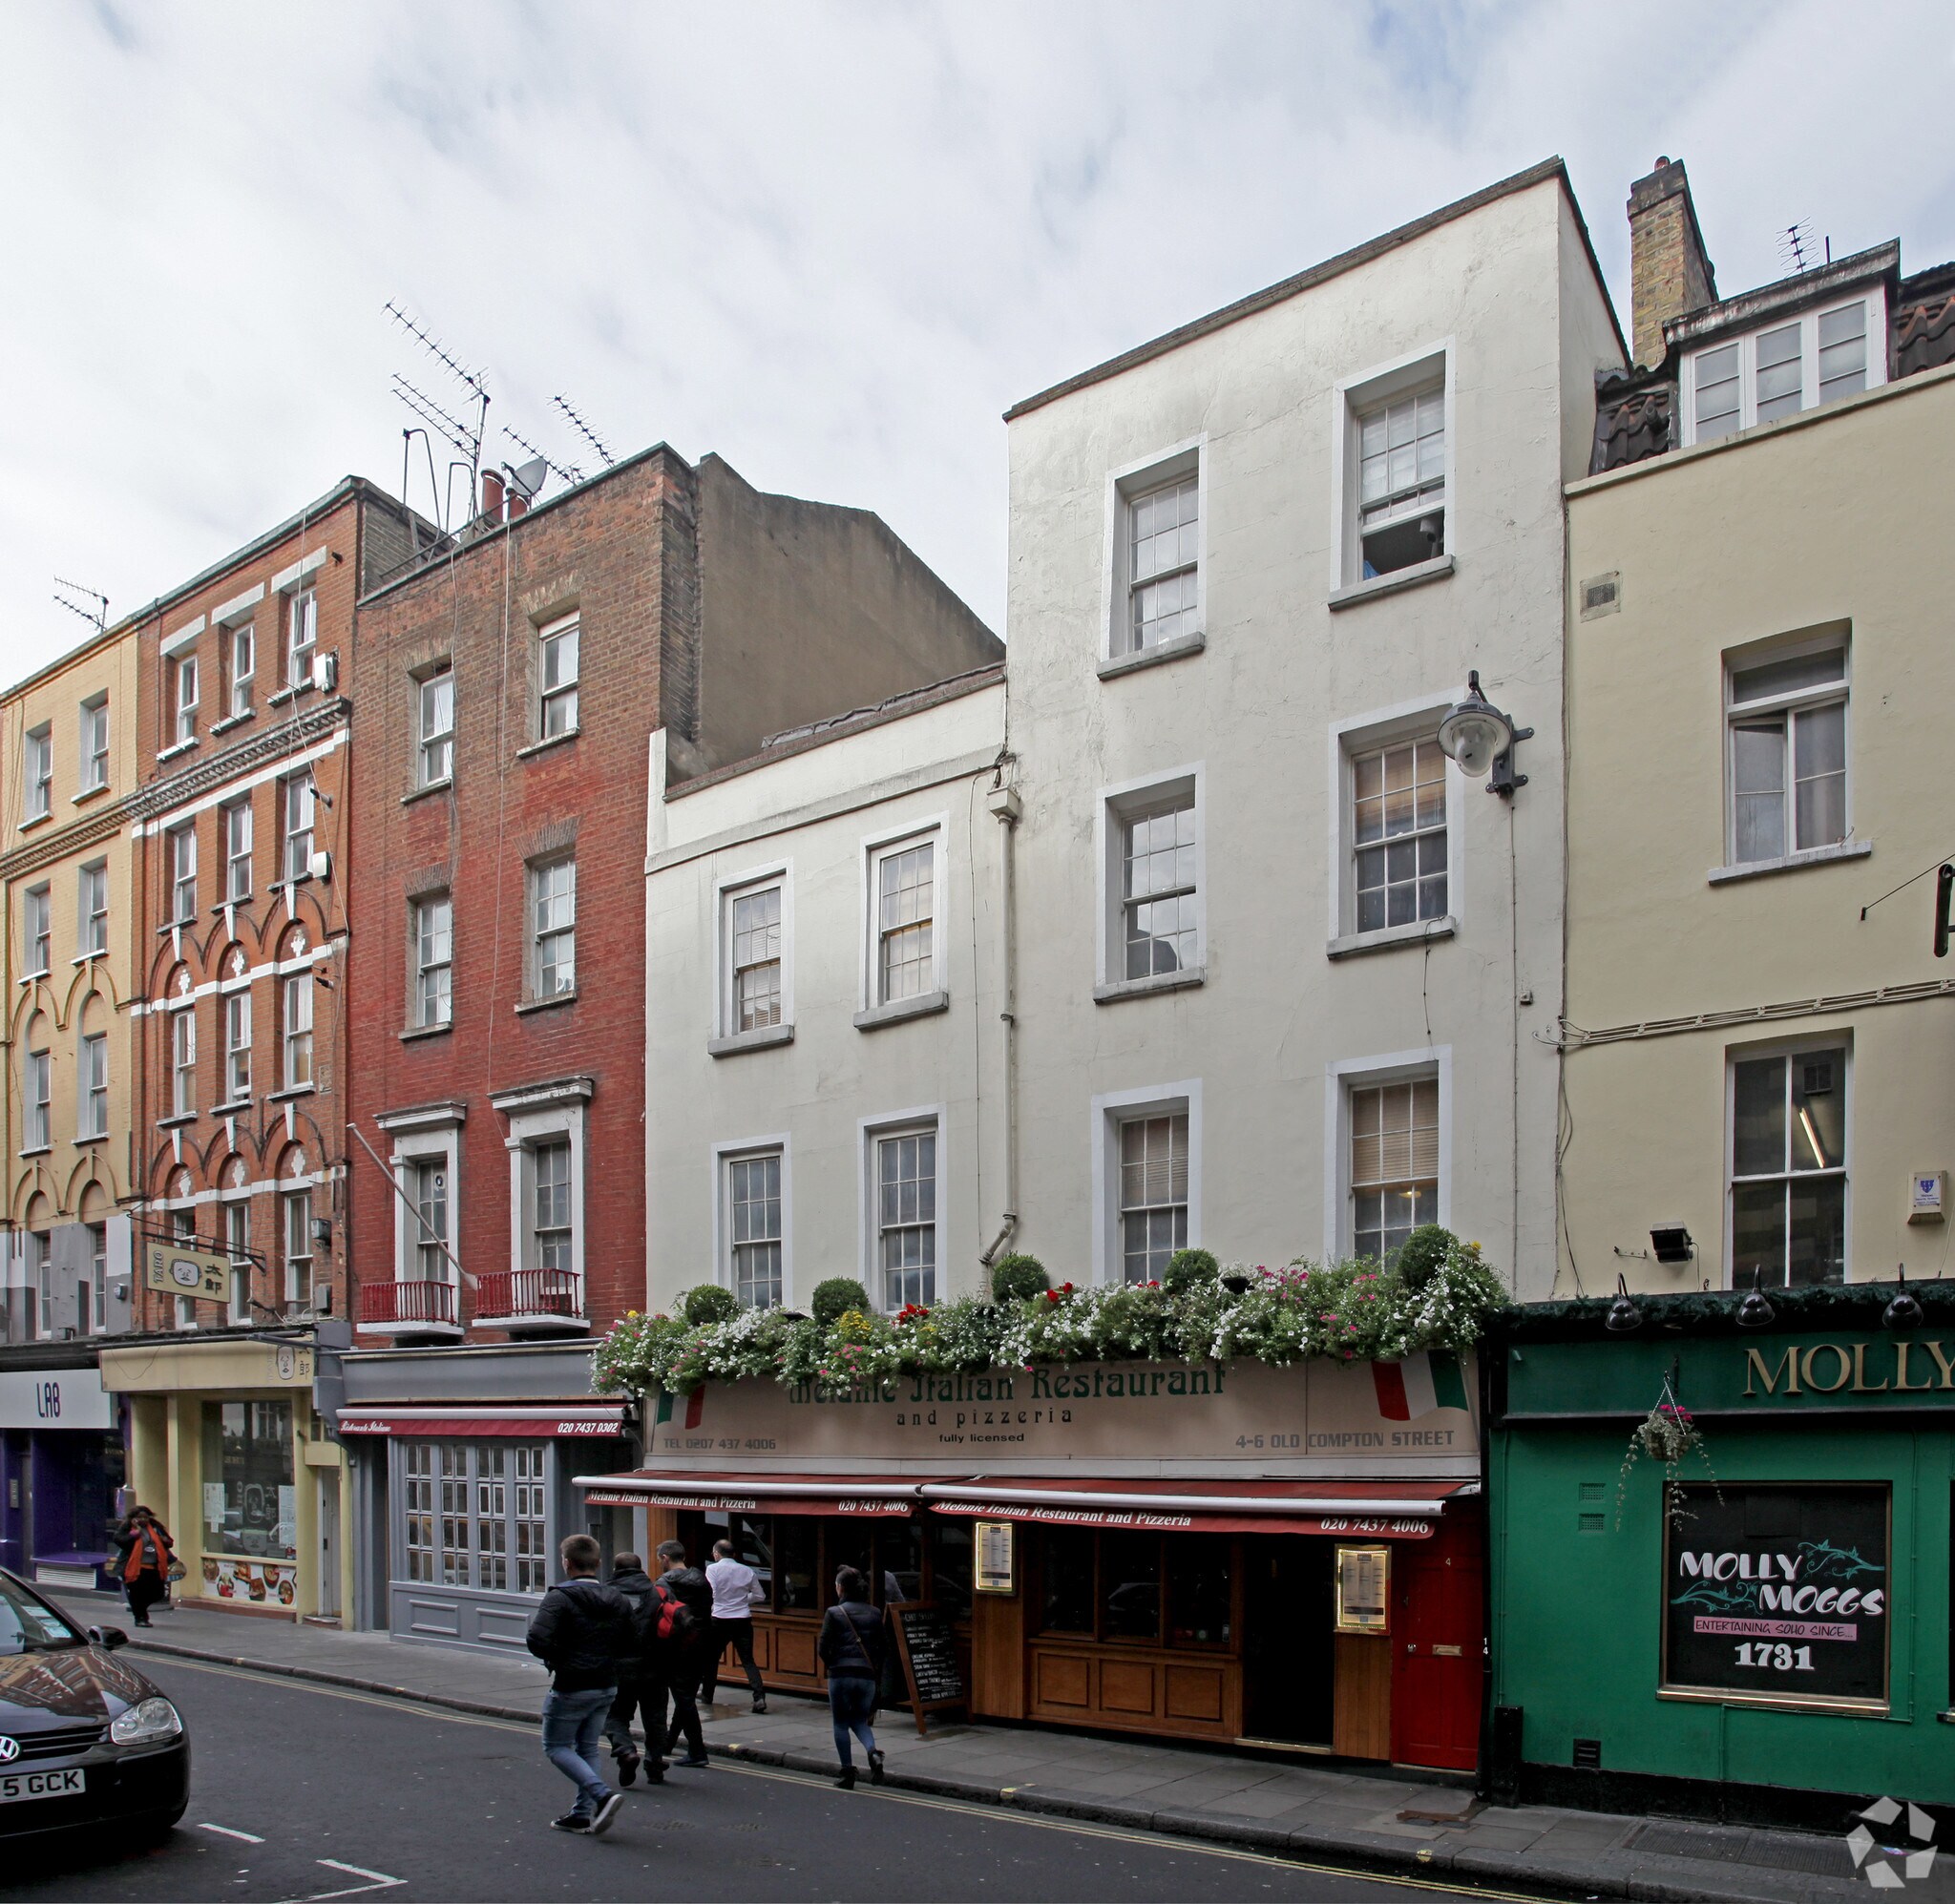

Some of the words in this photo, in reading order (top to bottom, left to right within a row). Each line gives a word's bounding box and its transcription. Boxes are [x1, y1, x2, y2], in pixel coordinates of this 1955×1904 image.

[153, 1250, 163, 1284] TARO
[204, 1264, 223, 1295] 太郎
[1742, 1341, 1955, 1395] MOLLY
[910, 1372, 1014, 1402] Italian
[1031, 1364, 1226, 1399] Restaurant
[36, 1382, 61, 1418] LAB
[557, 1422, 574, 1433] 020
[575, 1422, 597, 1433] 7437
[897, 1410, 936, 1426] and
[956, 1407, 1072, 1428] pizzeria
[663, 1438, 682, 1449] TEL
[685, 1438, 714, 1449] 0207
[718, 1438, 740, 1450] 437
[745, 1438, 776, 1450] 4006
[939, 1433, 964, 1444] fully
[970, 1433, 1024, 1443] licensed
[1235, 1434, 1264, 1448] 4-6
[1271, 1434, 1299, 1448] OLD
[1308, 1433, 1384, 1448] COMPTON
[1392, 1431, 1455, 1446] STREET
[588, 1490, 620, 1501] Melanie
[620, 1492, 648, 1504] Italian
[650, 1494, 698, 1507] Restaurant
[700, 1497, 717, 1508] and
[720, 1497, 756, 1509] Pizzeria
[838, 1500, 856, 1512] 020
[859, 1500, 882, 1512] 7437
[883, 1500, 908, 1513] 4006
[935, 1500, 985, 1512] Melanie
[986, 1502, 1028, 1517] Italian
[1031, 1506, 1103, 1522] Restaurant
[1105, 1512, 1132, 1524] and
[1135, 1512, 1191, 1526] Pizzeria
[1321, 1517, 1348, 1530] 020
[1353, 1518, 1388, 1532] 7437
[1391, 1519, 1428, 1533] 4006
[1445, 1558, 1451, 1566] 4
[1680, 1552, 1802, 1580] MOLLY
[1759, 1584, 1884, 1616] MOGGS
[1695, 1620, 1772, 1634] ENTERTAINING
[1776, 1623, 1805, 1636] SOHO
[1734, 1642, 1815, 1670] 1731
[28, 1771, 80, 1794] GCK
